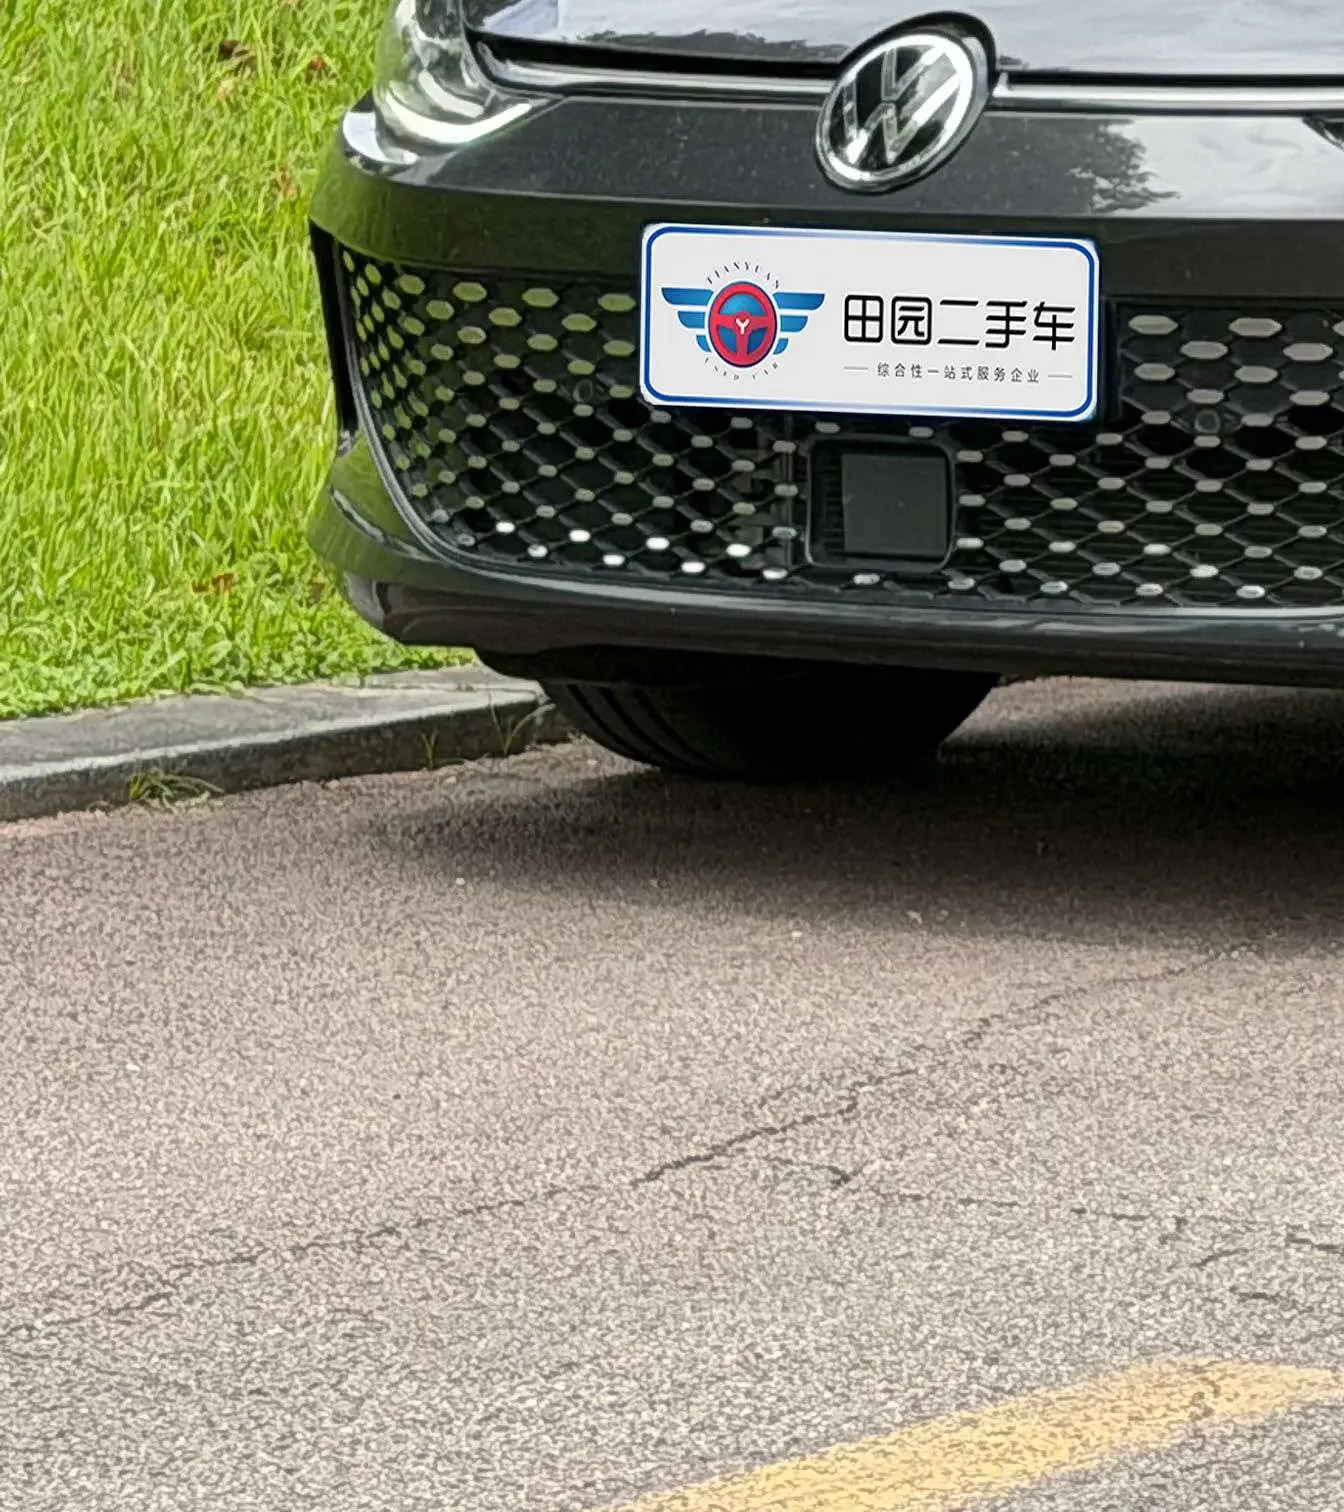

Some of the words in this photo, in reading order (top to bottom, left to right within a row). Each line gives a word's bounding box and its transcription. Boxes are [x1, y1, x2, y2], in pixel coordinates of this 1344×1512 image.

[824, 38, 968, 176] VW
[735, 317, 750, 336] Y
[844, 294, 1076, 351] 田园二手车
[876, 361, 1040, 384] 综合性一站式服务企业
